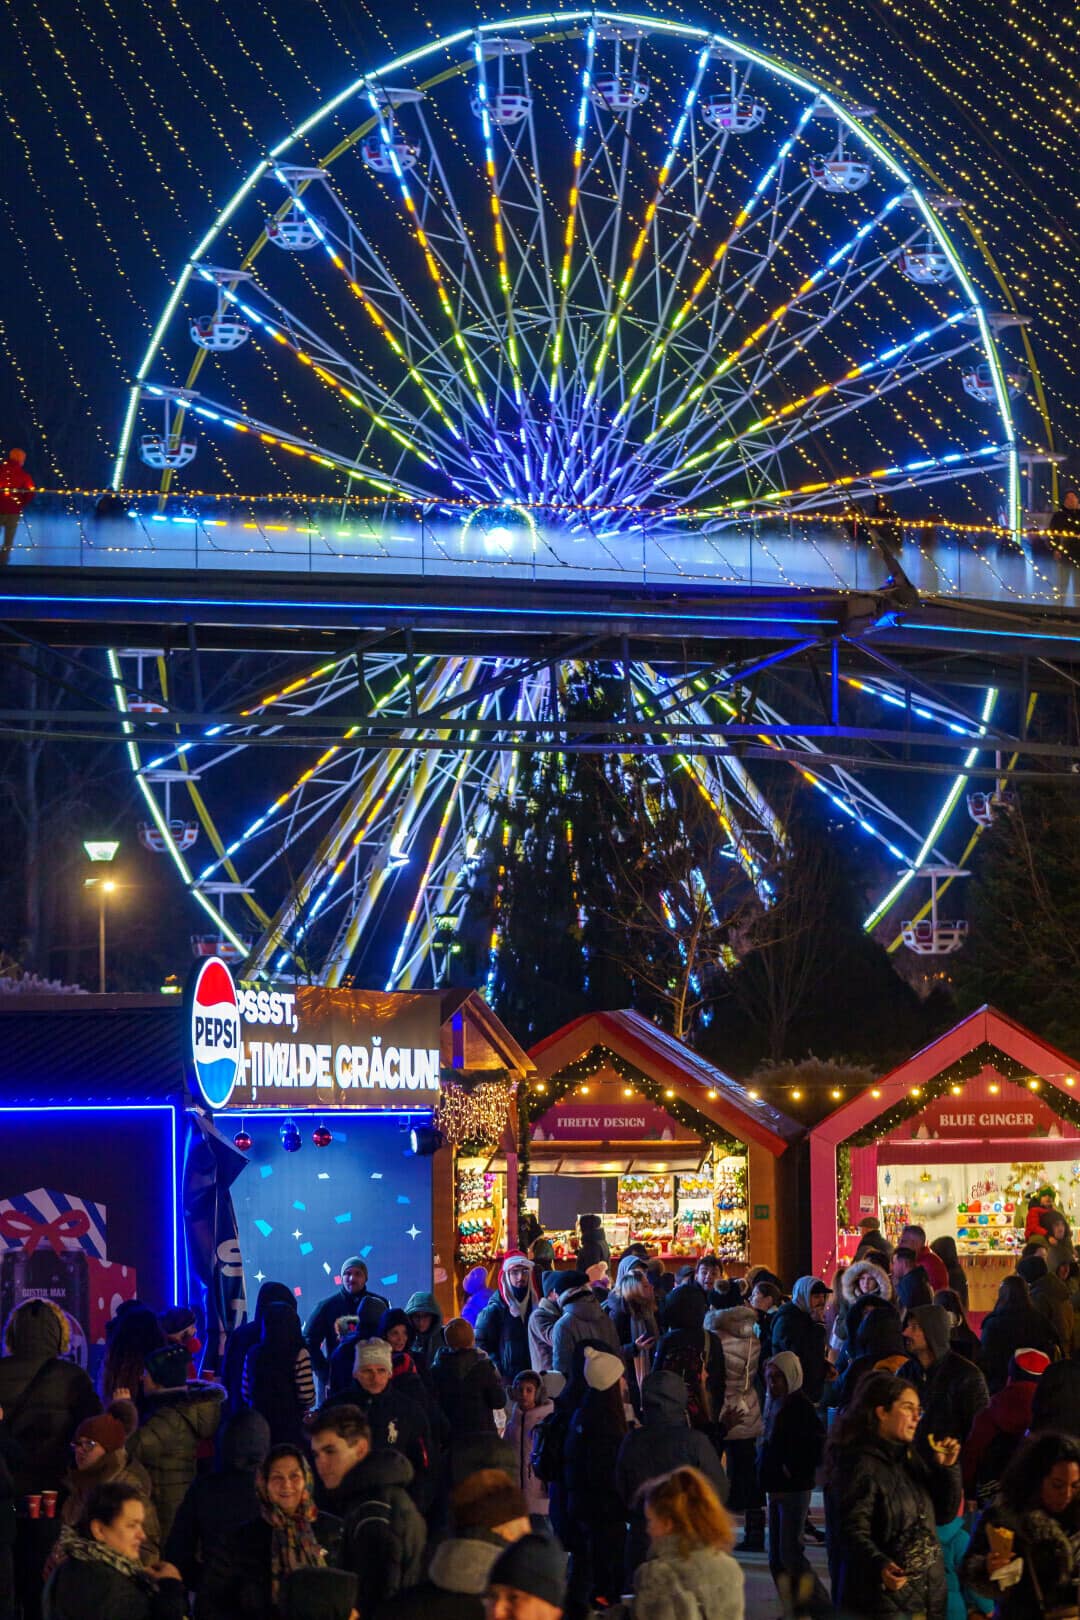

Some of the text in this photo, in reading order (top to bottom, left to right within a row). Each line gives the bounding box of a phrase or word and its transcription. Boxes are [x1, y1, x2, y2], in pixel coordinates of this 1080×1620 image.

[195, 1016, 238, 1049] PEPSI
[299, 1044, 332, 1088] DE
[334, 1036, 440, 1091] CRĂCIUN!
[557, 1117, 646, 1128] FIREFLY DESIGN
[939, 1112, 1035, 1127] BLUE GINGER
[50, 1287, 66, 1297] MAX
